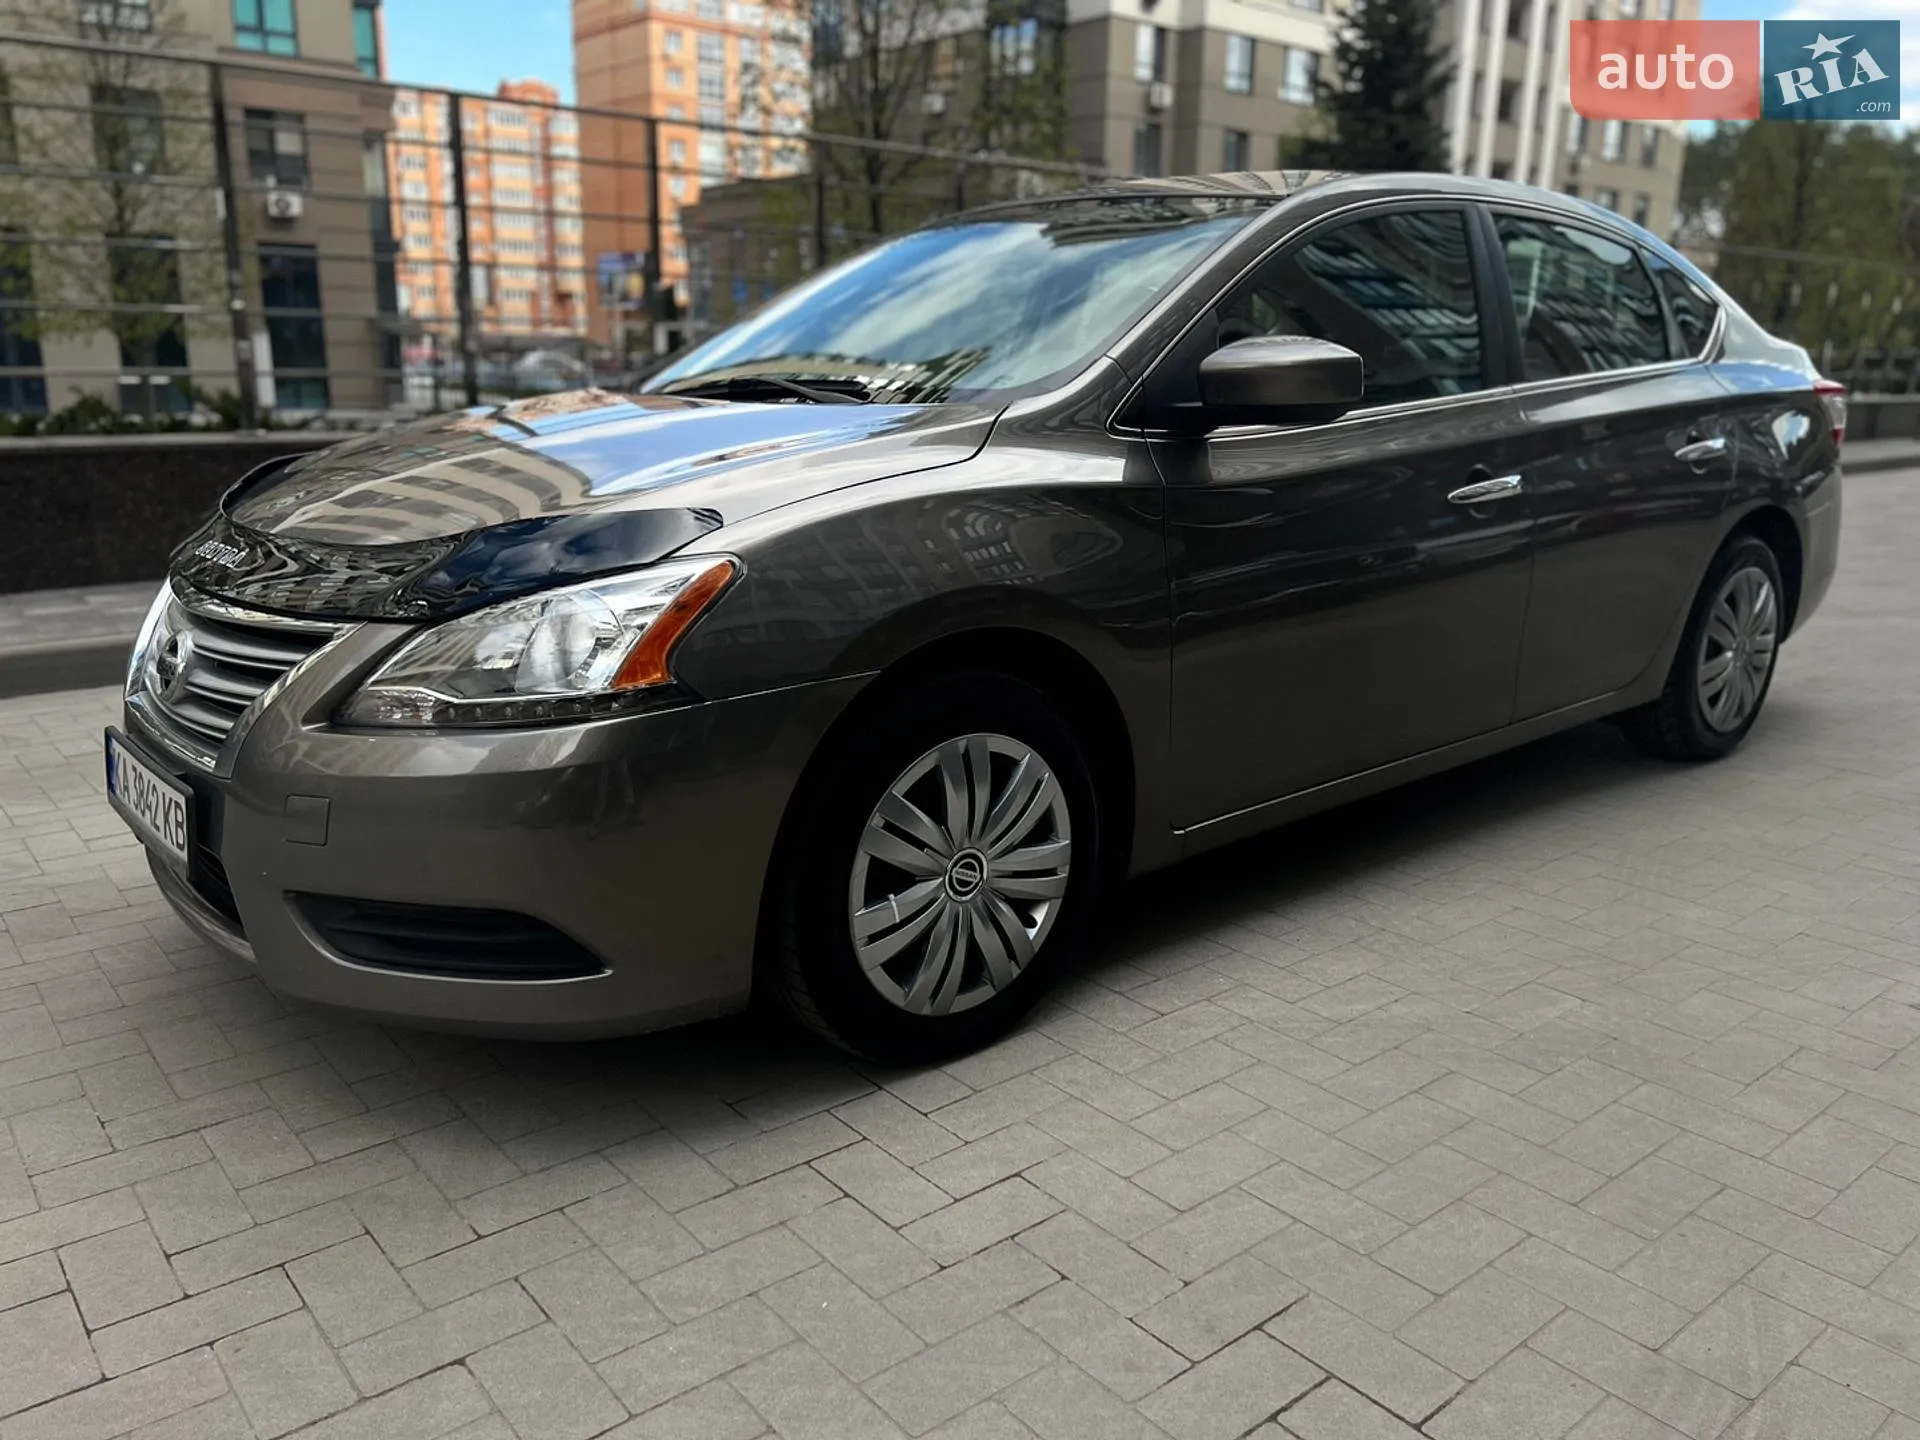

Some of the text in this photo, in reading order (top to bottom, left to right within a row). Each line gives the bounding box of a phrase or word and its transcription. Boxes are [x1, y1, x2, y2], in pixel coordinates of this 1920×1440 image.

[115, 752, 185, 852] KA 3842 KB
